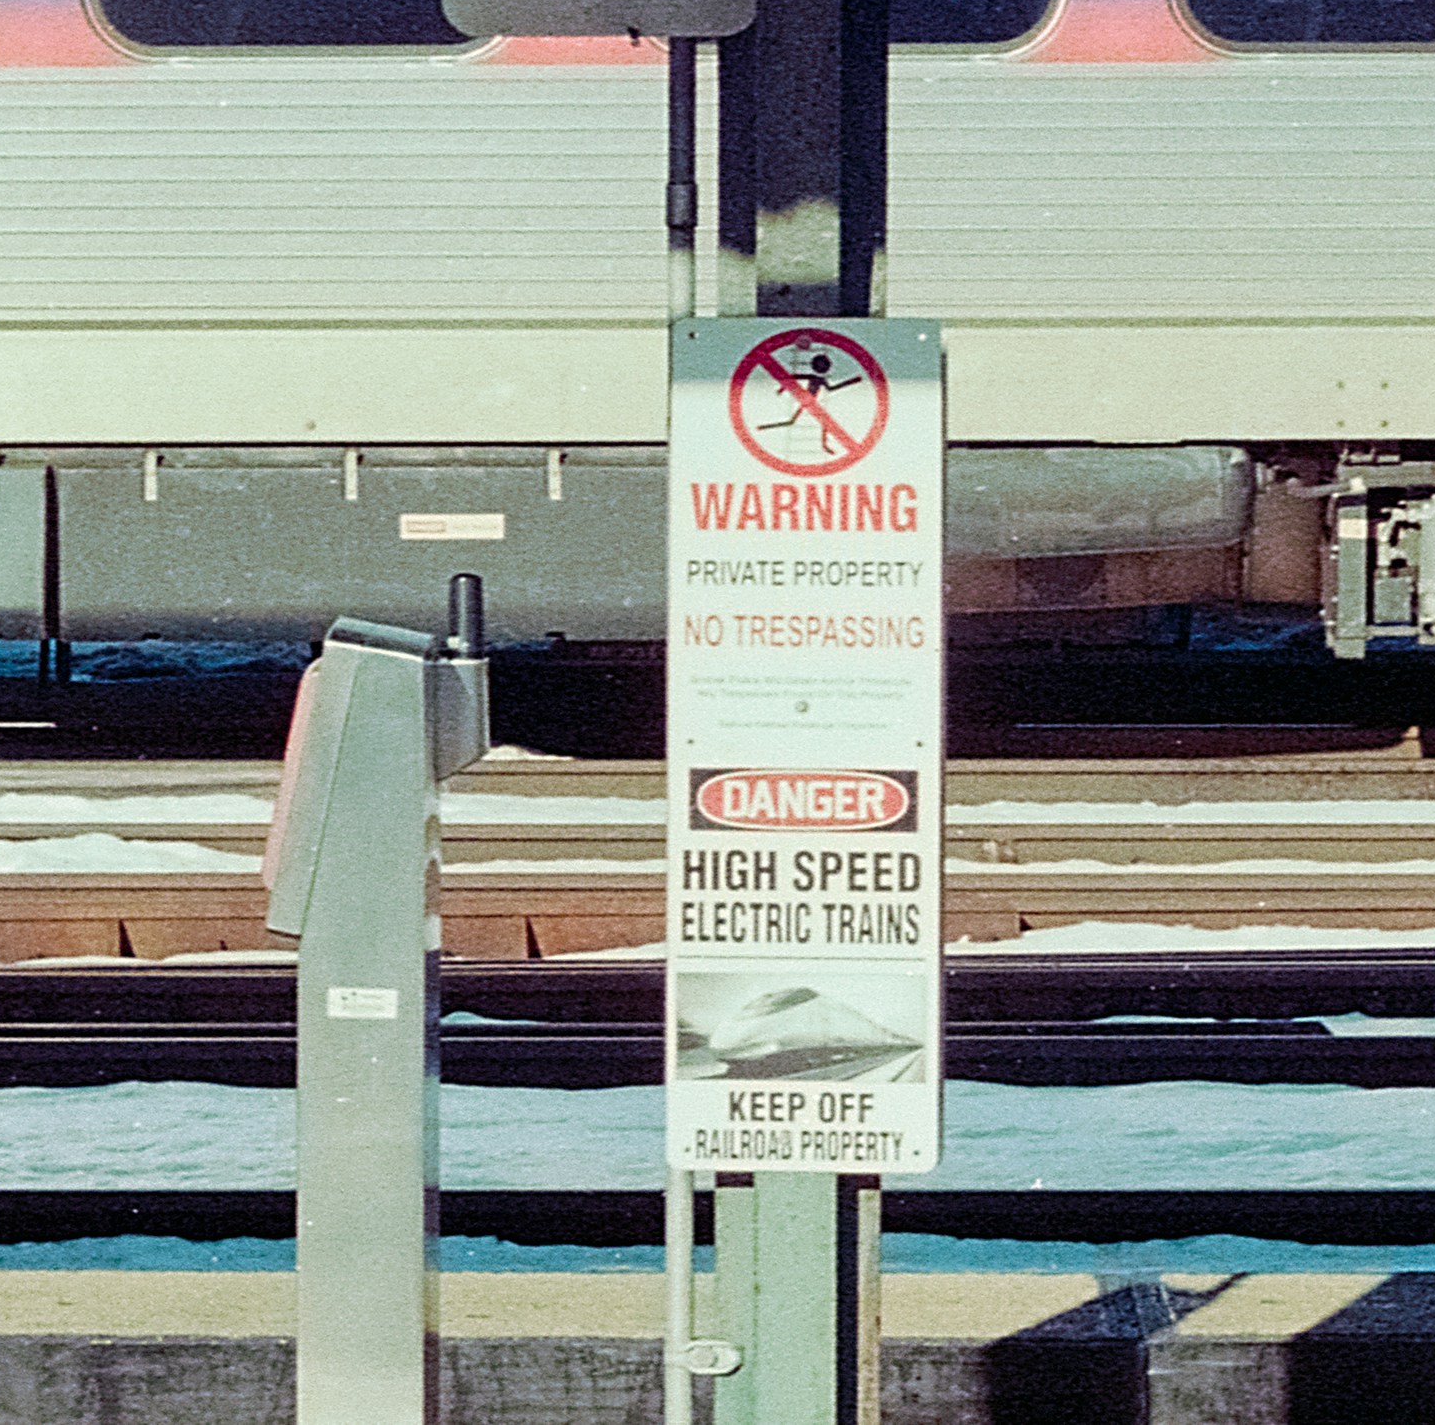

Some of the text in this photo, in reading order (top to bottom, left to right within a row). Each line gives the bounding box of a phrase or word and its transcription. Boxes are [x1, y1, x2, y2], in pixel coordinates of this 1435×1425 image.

[691, 482, 919, 533] WARNING
[687, 559, 924, 588] PRIVATE PROPERTY
[684, 614, 926, 649] NO TRESPASSING
[725, 780, 886, 822] DANGER
[683, 849, 921, 892] HIGH SPEED
[681, 901, 920, 945] ELECTRIC TRAINS
[728, 1090, 875, 1124] KEEP OFF
[695, 1128, 904, 1162] RAILROAD PROPERTY
